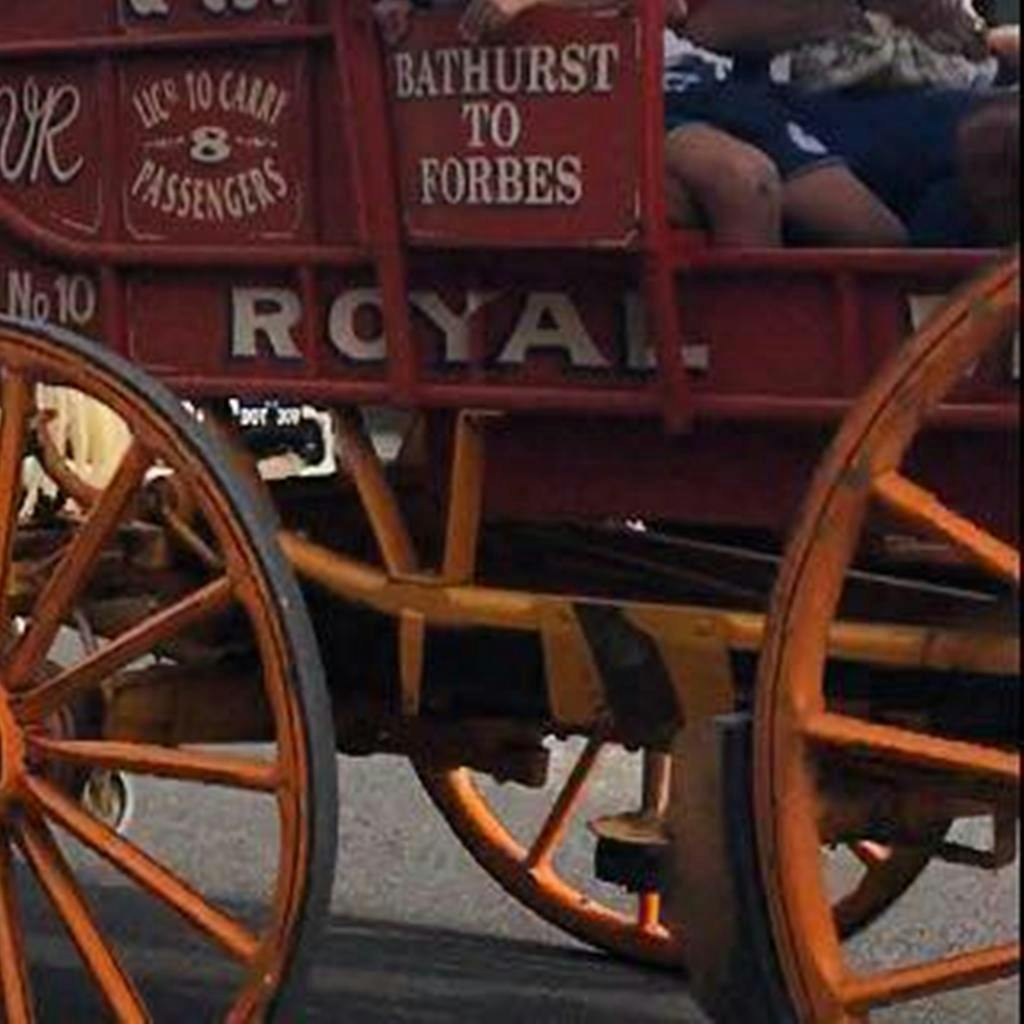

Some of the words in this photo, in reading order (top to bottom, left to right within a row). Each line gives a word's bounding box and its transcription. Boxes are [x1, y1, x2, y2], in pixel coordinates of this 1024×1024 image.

[184, 70, 213, 112] TO
[218, 69, 289, 124] CARRY
[395, 43, 619, 98] BATHURST
[189, 126, 232, 163] 8
[462, 100, 522, 148] TO
[131, 157, 288, 223] PASSENGERS
[420, 154, 584, 205] FORBES
